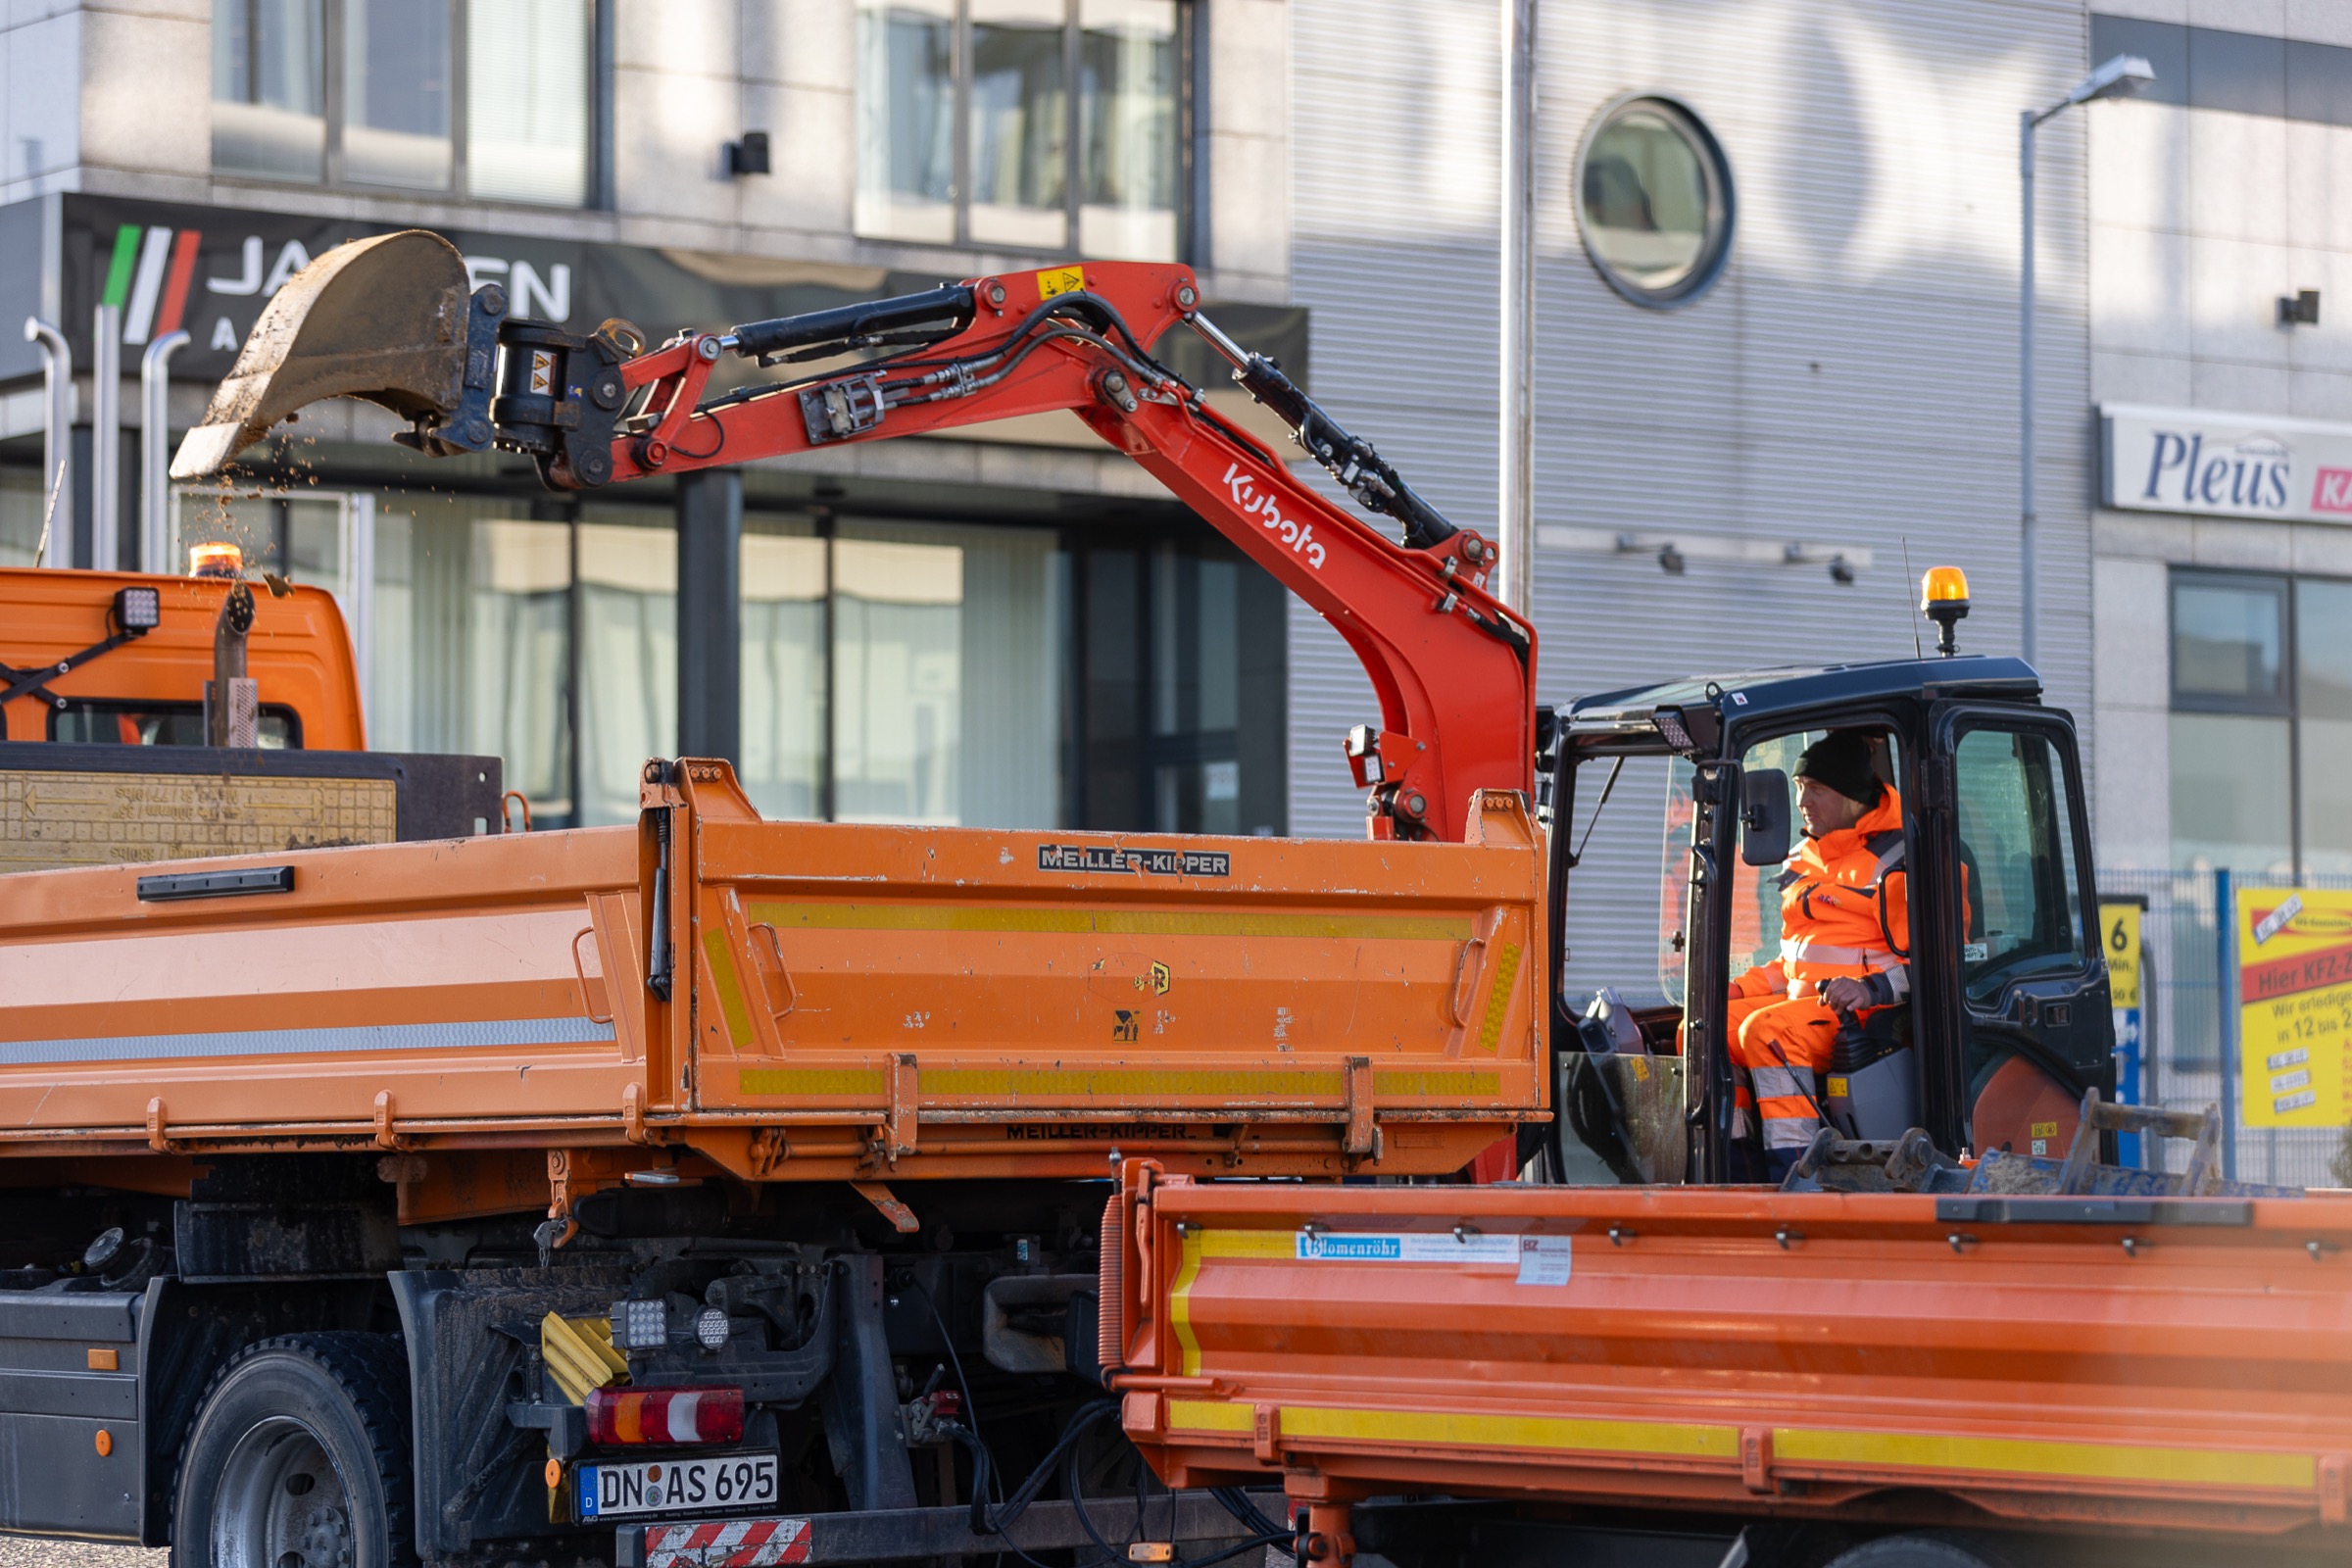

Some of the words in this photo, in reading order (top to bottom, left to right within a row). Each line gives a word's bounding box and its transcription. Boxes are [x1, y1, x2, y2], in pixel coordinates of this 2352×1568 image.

[206, 234, 571, 324] JAEN
[2141, 428, 2290, 511] Pleus
[1222, 462, 1326, 570] Kubota
[2110, 916, 2128, 952] 6
[2258, 967, 2298, 993] Hier
[2294, 1016, 2314, 1039] 12
[1306, 1236, 1397, 1257] Blomenröhr
[585, 1496, 593, 1508] D
[601, 1469, 643, 1508] DN
[665, 1464, 707, 1505] AS
[715, 1461, 774, 1501] 695
